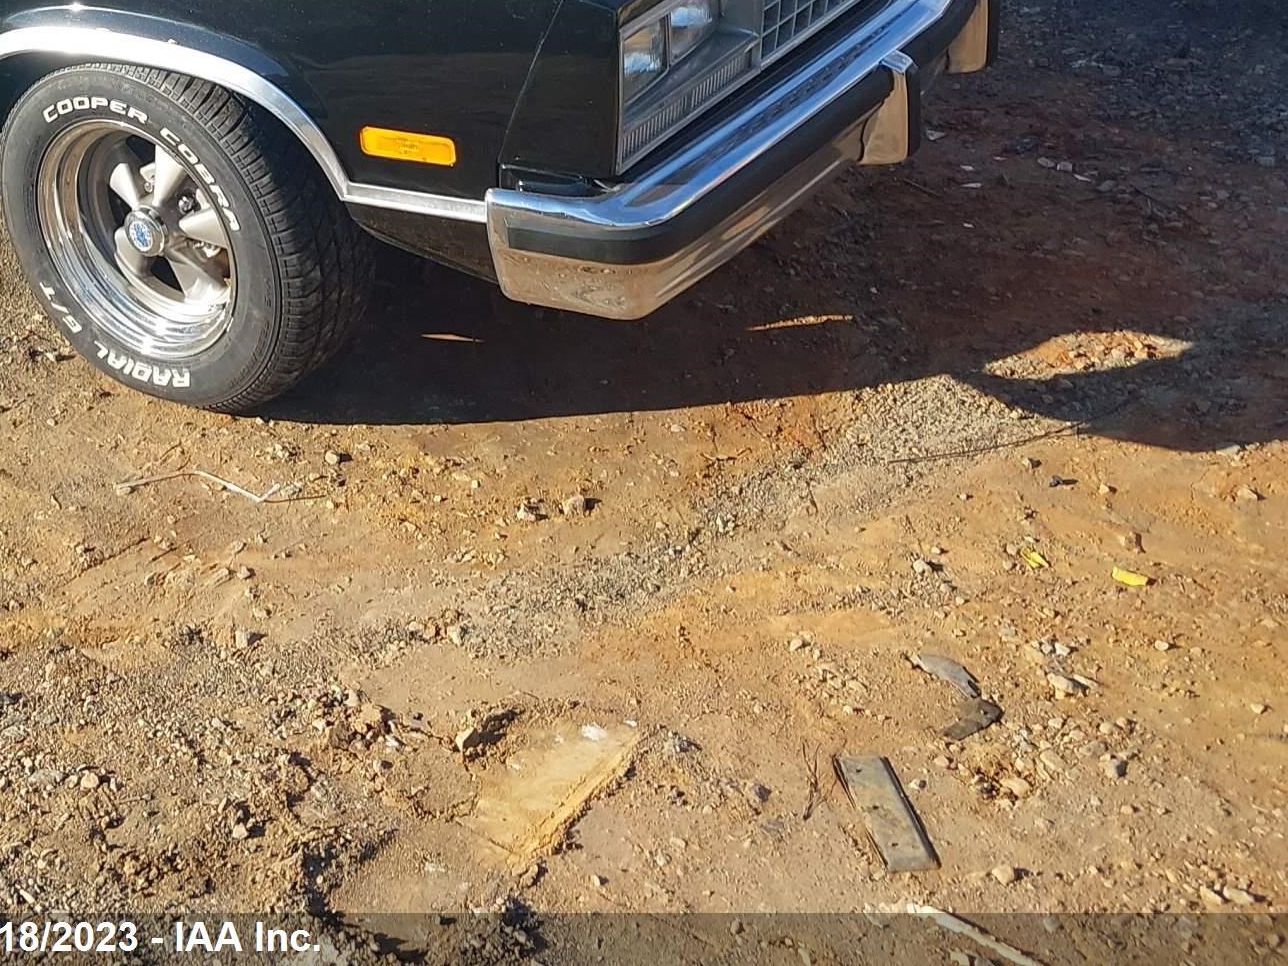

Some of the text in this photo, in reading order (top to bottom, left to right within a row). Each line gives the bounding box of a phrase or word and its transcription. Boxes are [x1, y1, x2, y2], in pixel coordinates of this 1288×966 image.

[42, 97, 241, 232] COOPER COBRA
[39, 282, 192, 388] RADIAL G/T
